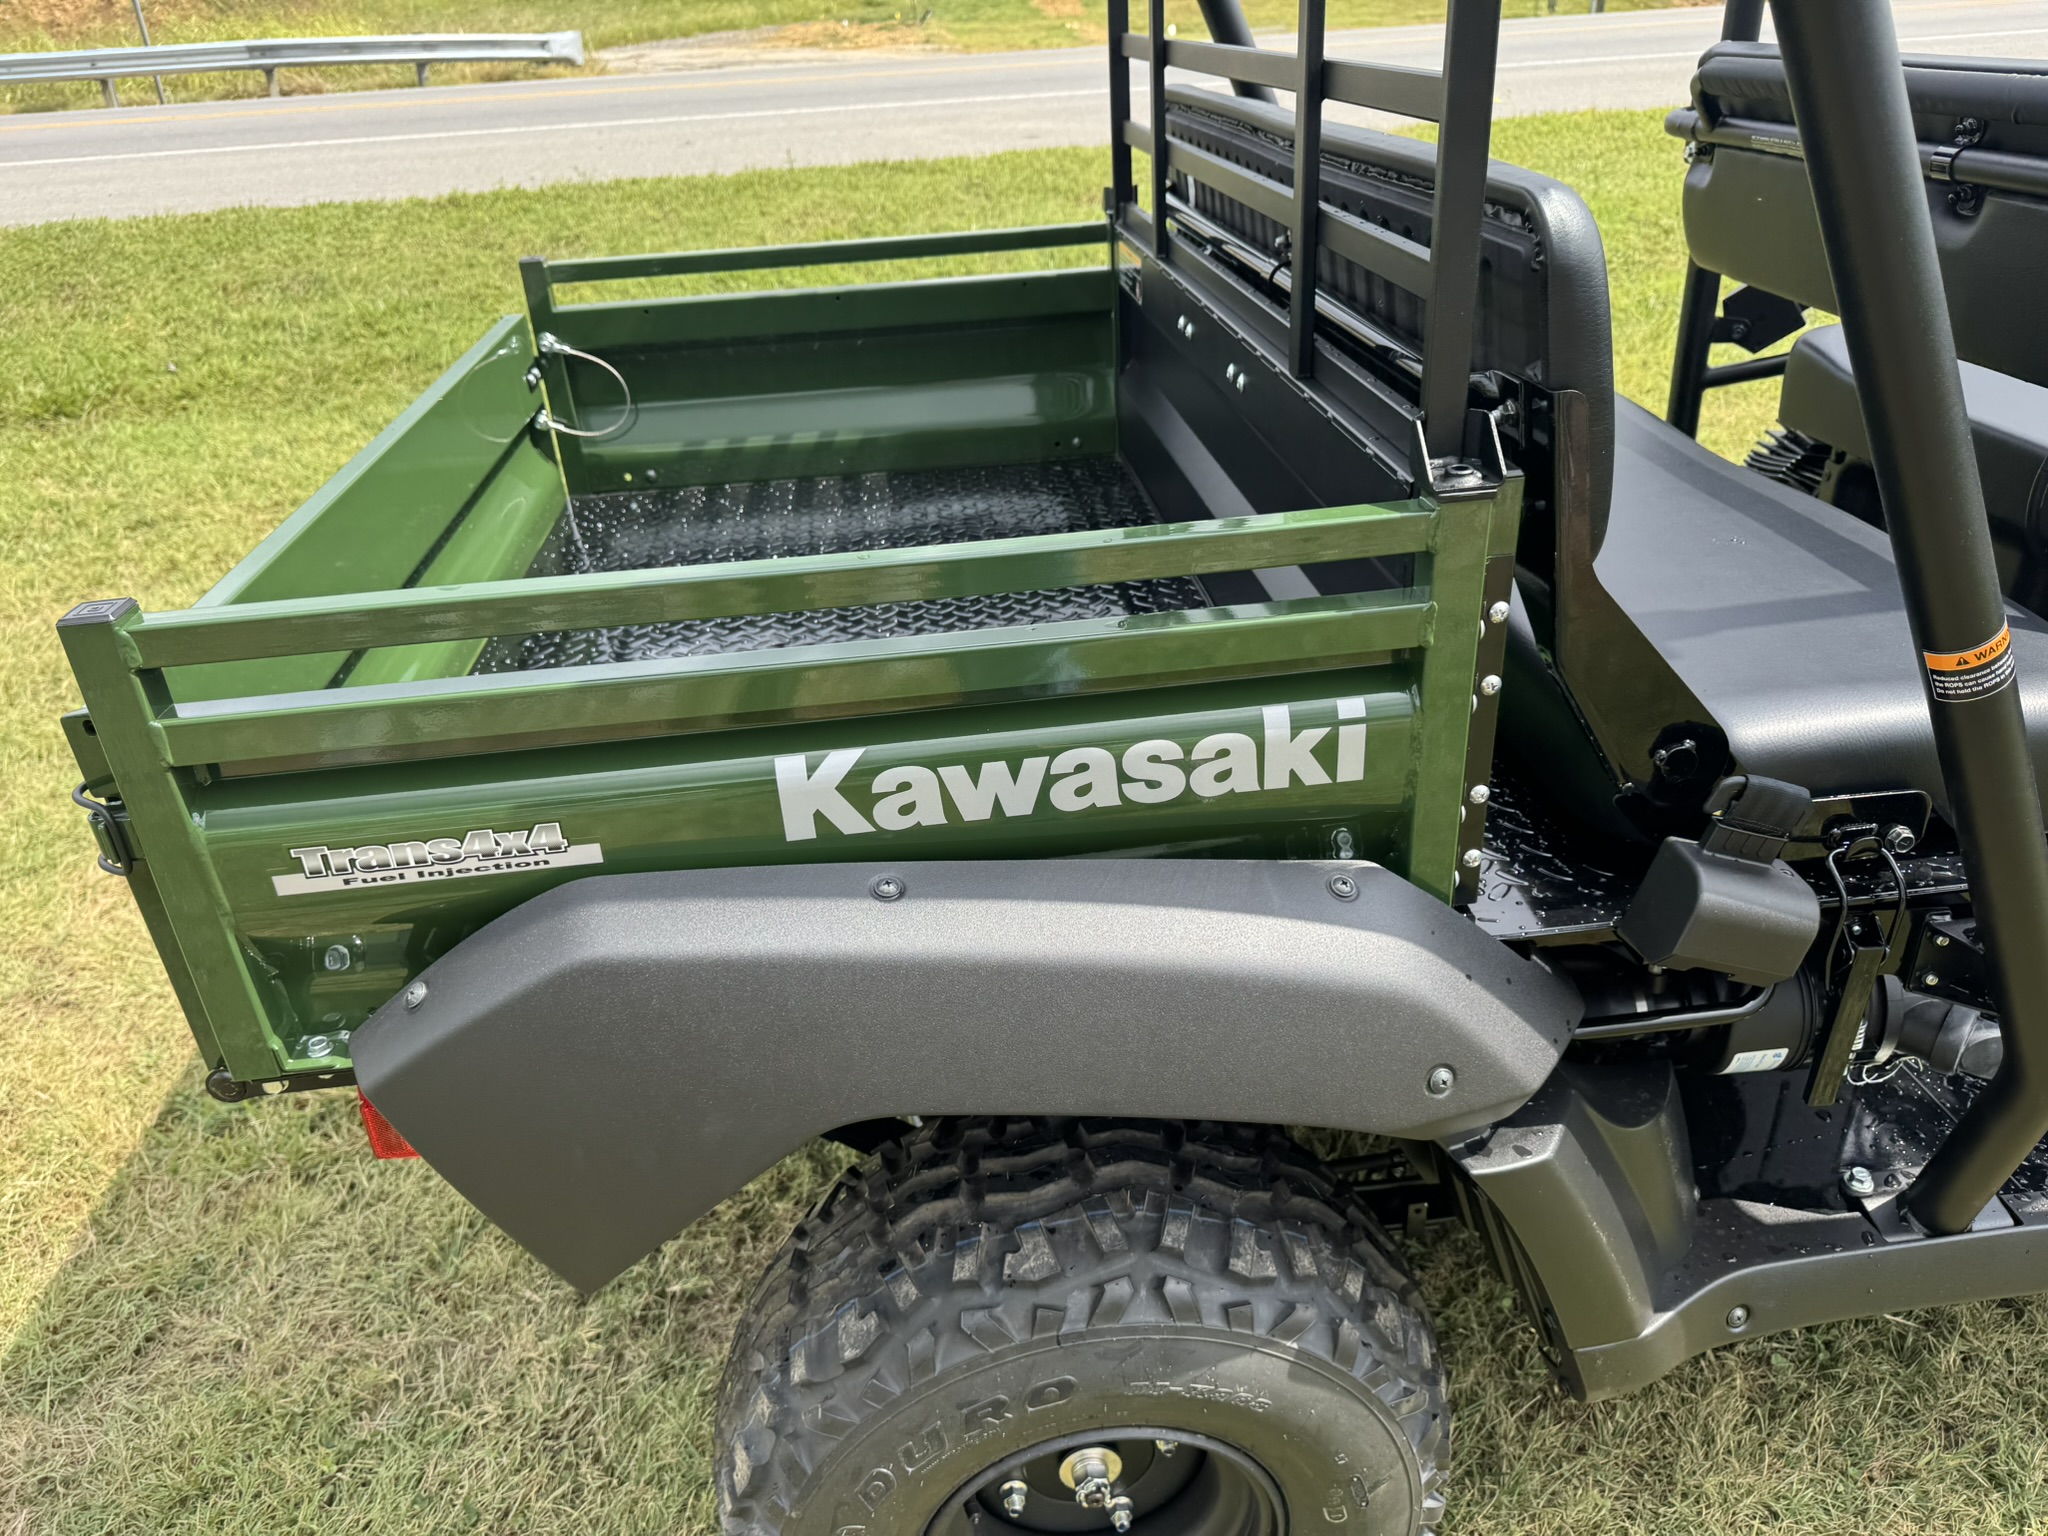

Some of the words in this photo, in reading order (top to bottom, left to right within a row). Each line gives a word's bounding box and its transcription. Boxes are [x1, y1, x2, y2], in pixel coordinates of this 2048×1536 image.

[1974, 628, 2009, 661] WARN
[1960, 668, 1990, 680] clearance
[1978, 673, 1995, 683] cause
[1983, 677, 2000, 688] ROPS
[774, 697, 1367, 843] Kawasaki
[289, 822, 569, 879] Trans4x4
[342, 872, 406, 886] Fuel
[417, 858, 551, 878] Injection
[854, 1374, 1079, 1512] DURO
